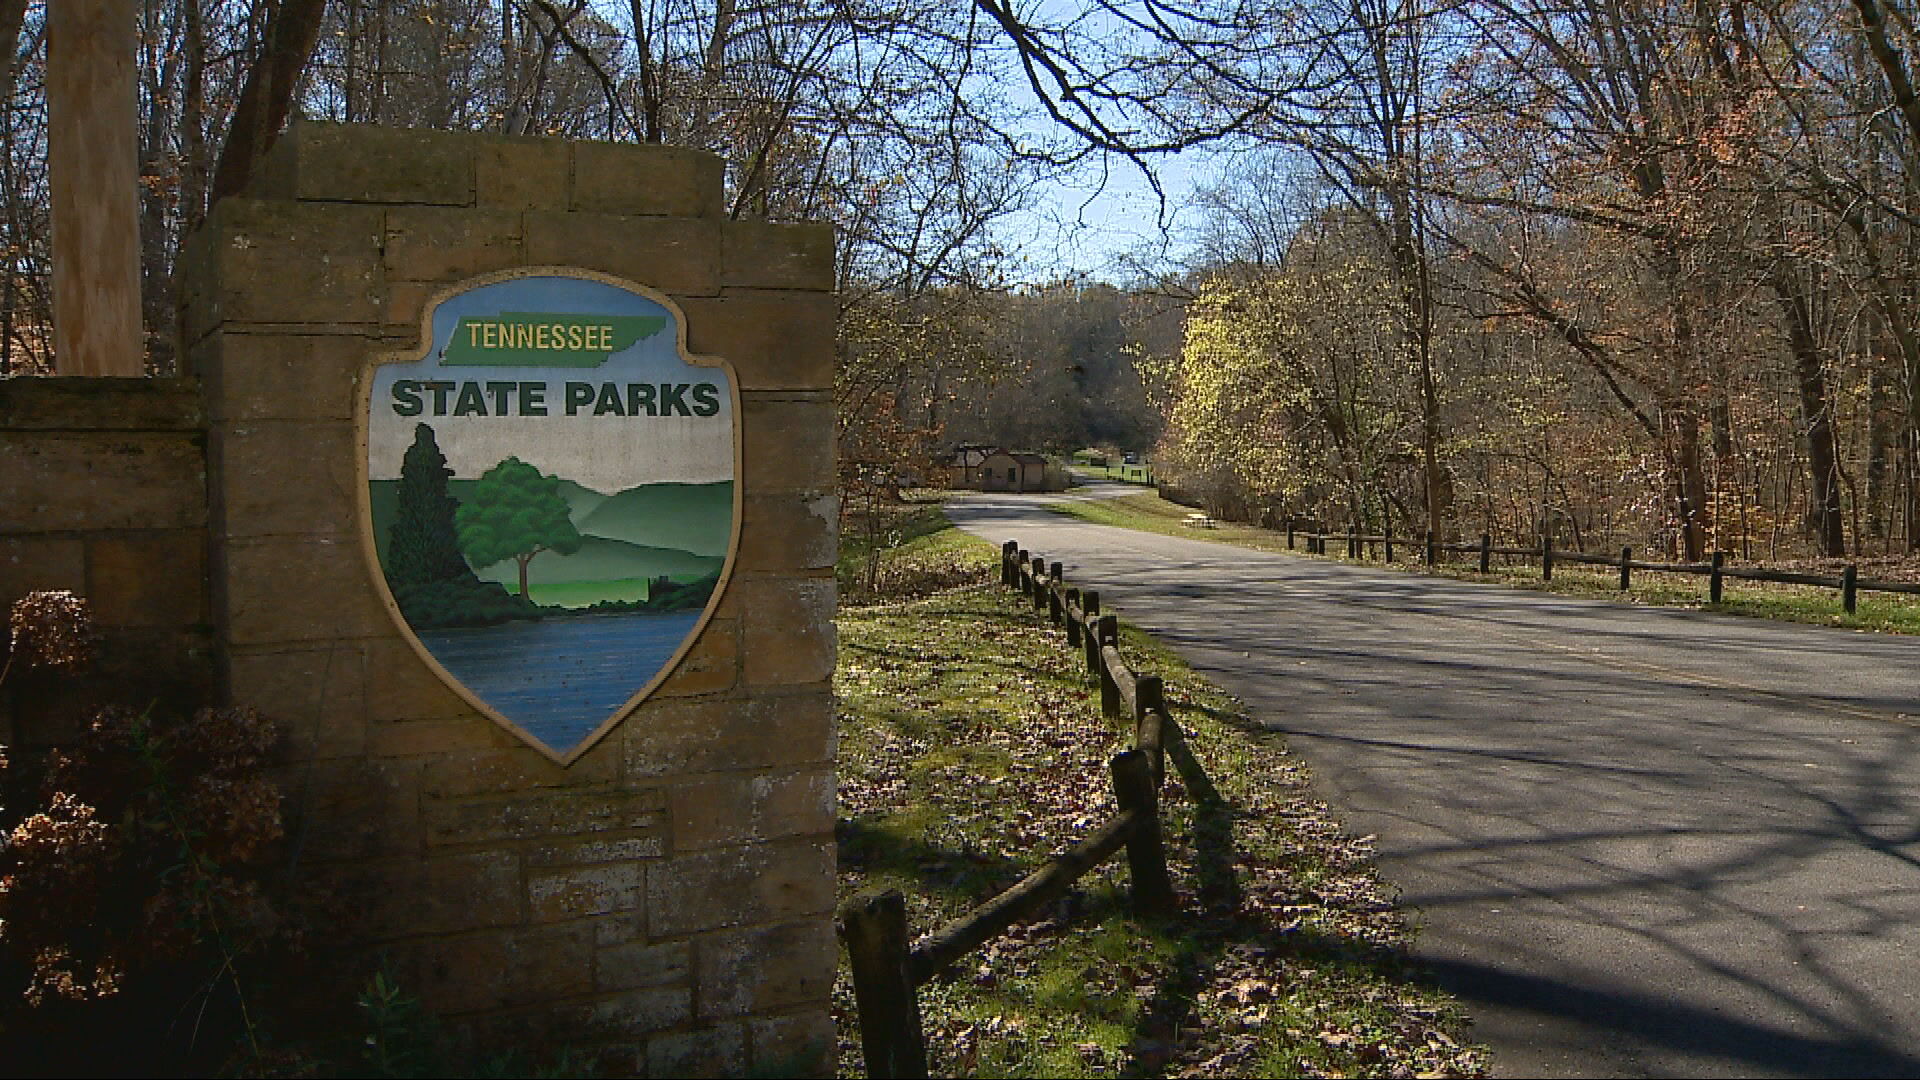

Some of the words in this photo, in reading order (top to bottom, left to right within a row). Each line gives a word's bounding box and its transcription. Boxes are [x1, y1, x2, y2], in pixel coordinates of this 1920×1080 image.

[466, 322, 614, 351] TENNESSEE
[391, 380, 547, 417] STATE
[565, 381, 720, 417] PARKS
